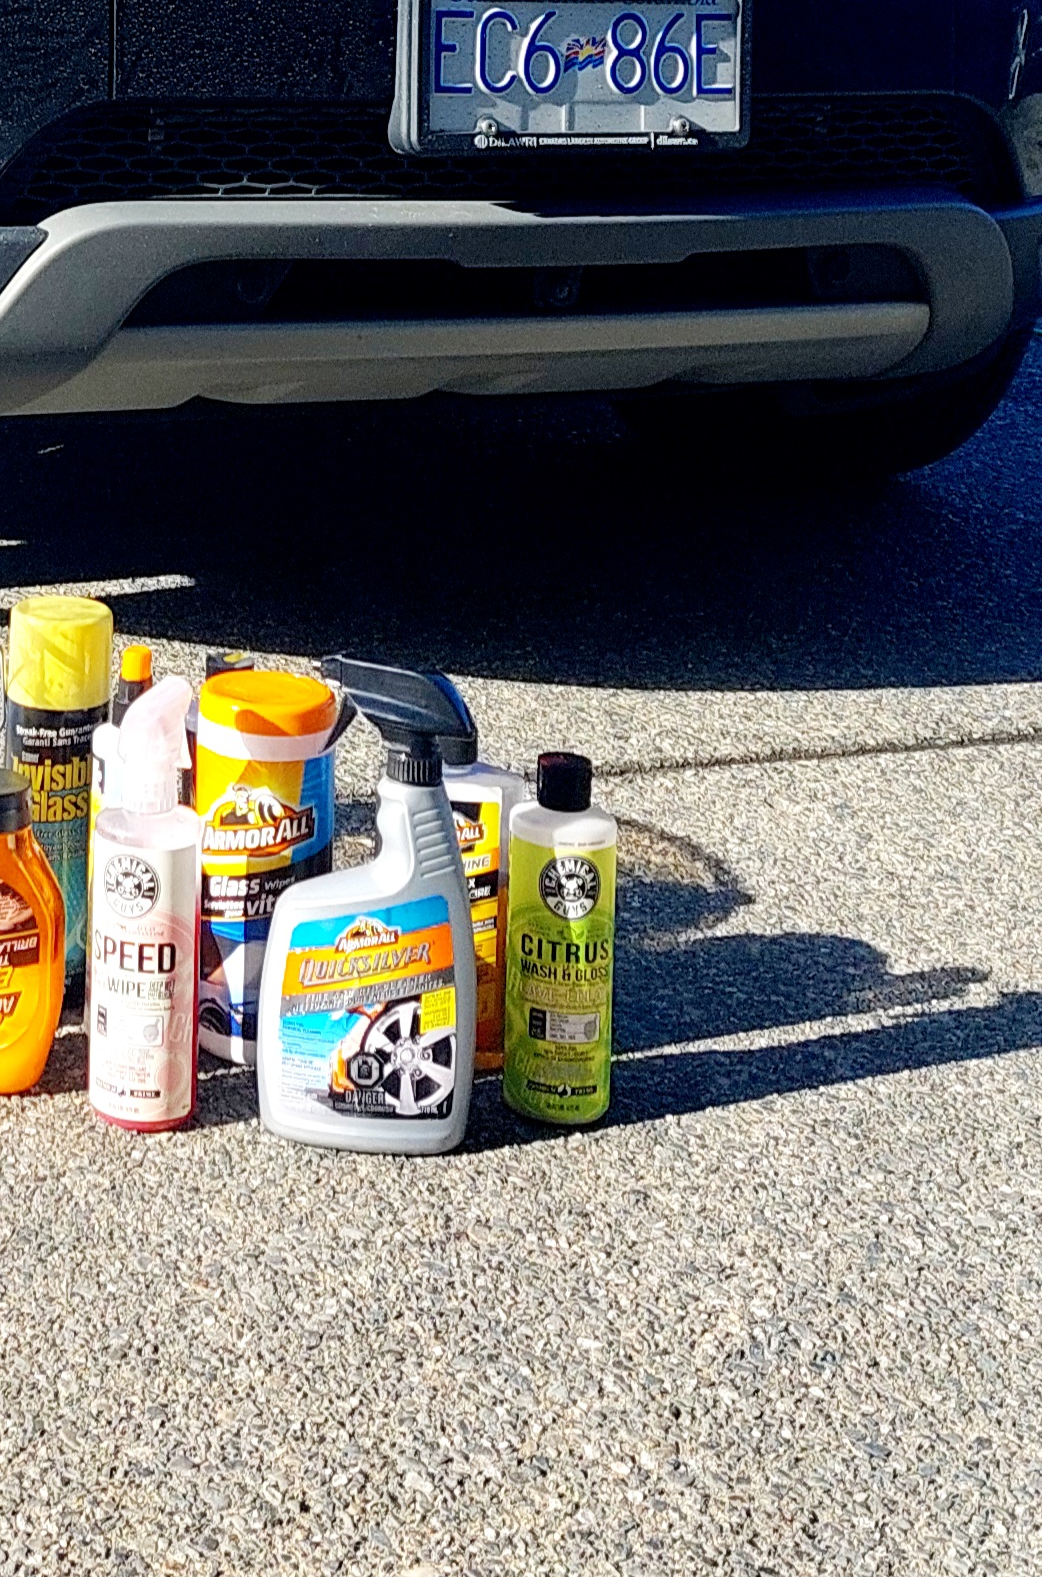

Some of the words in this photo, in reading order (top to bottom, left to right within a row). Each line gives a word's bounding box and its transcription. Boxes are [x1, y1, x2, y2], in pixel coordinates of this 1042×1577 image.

[433, 8, 562, 96] EC6
[607, 11, 735, 97] 86E
[11, 753, 92, 792] Invisibl
[209, 875, 261, 897] Glass
[544, 859, 597, 890] CHEMICAL
[553, 899, 588, 917] GUYS
[95, 929, 177, 975] SPEED
[299, 942, 431, 986] QUICKSILVER
[520, 933, 610, 965] CITRUS
[520, 958, 558, 980] WASH
[575, 964, 610, 983] GLOSS
[107, 975, 146, 999] WIPE
[345, 1090, 384, 1105] DANGER
